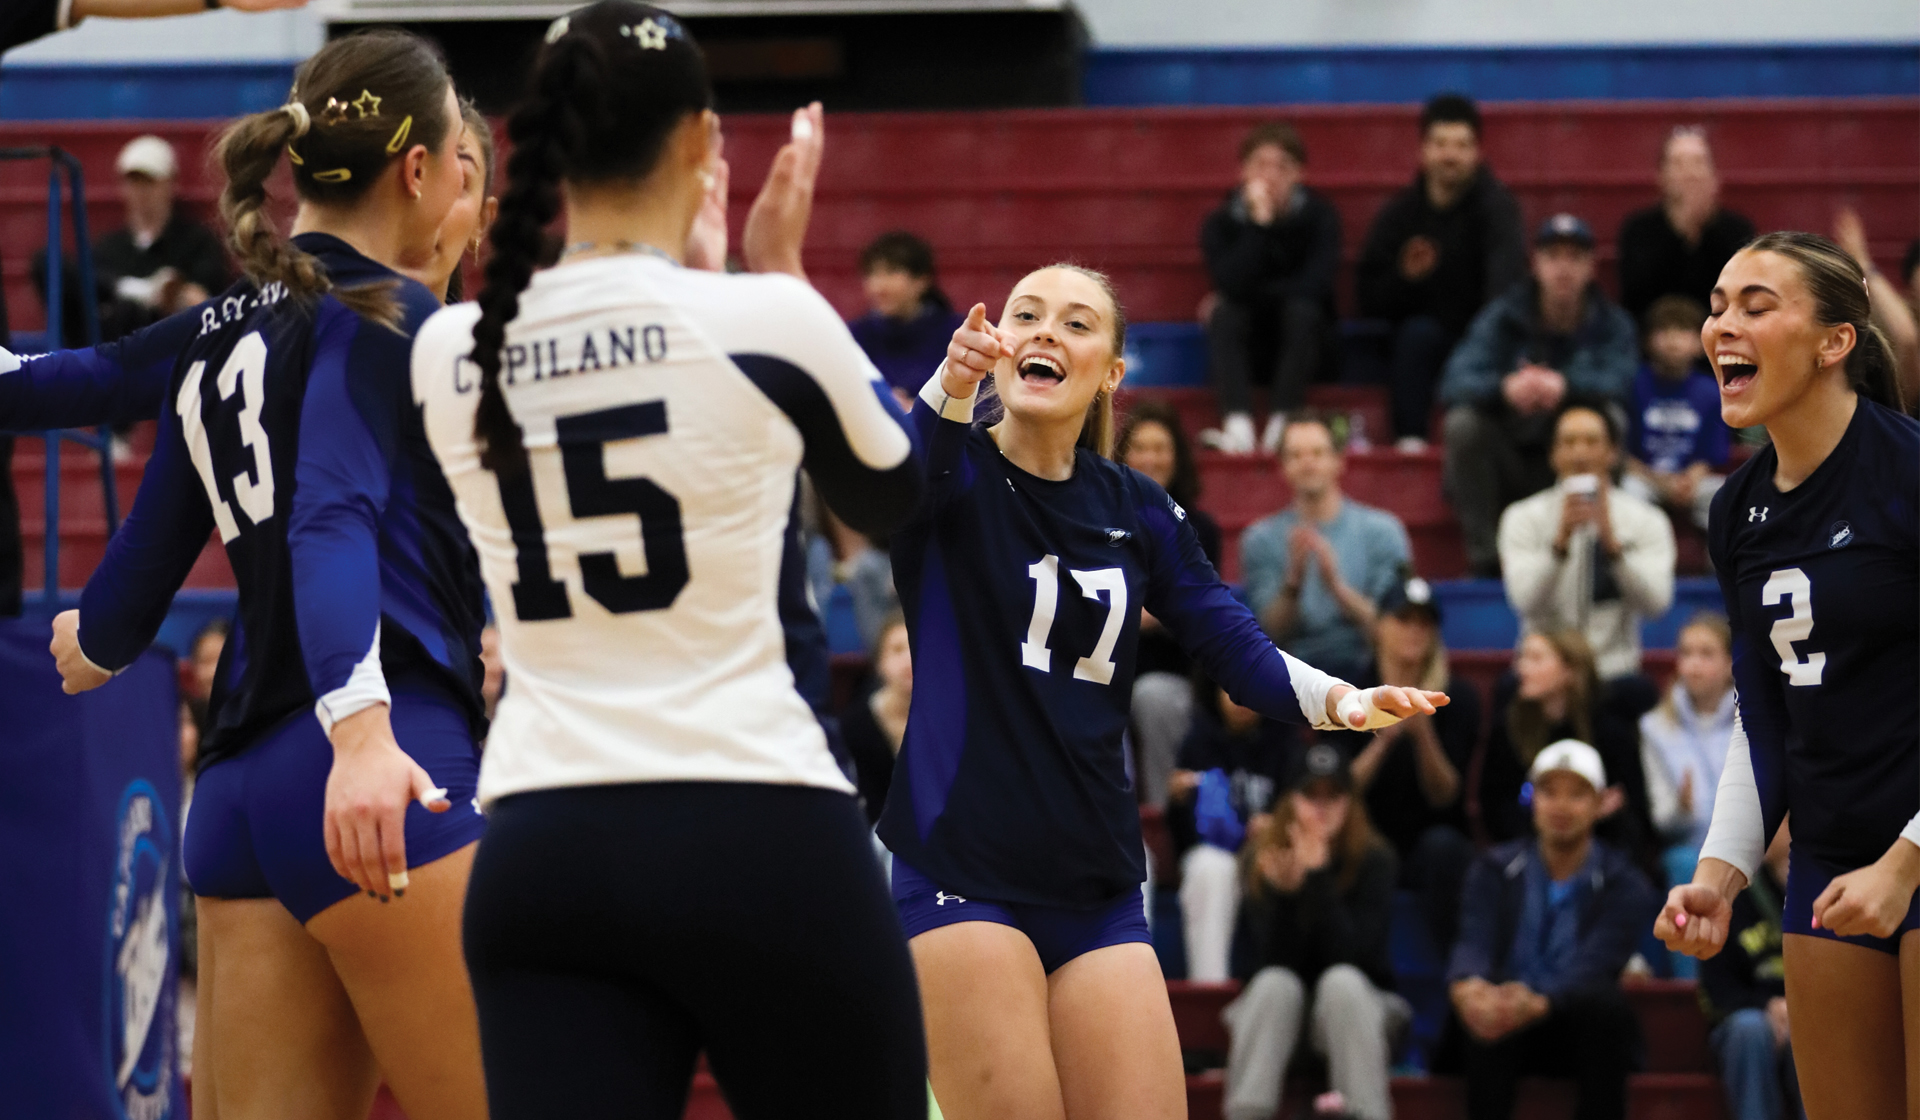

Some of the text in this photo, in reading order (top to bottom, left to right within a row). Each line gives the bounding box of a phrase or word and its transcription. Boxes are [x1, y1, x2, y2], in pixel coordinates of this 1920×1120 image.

[454, 324, 668, 395] CPILANO
[176, 330, 275, 546] 13
[498, 398, 691, 622] 15
[1021, 553, 1127, 686] 17
[1762, 567, 1827, 687] 2
